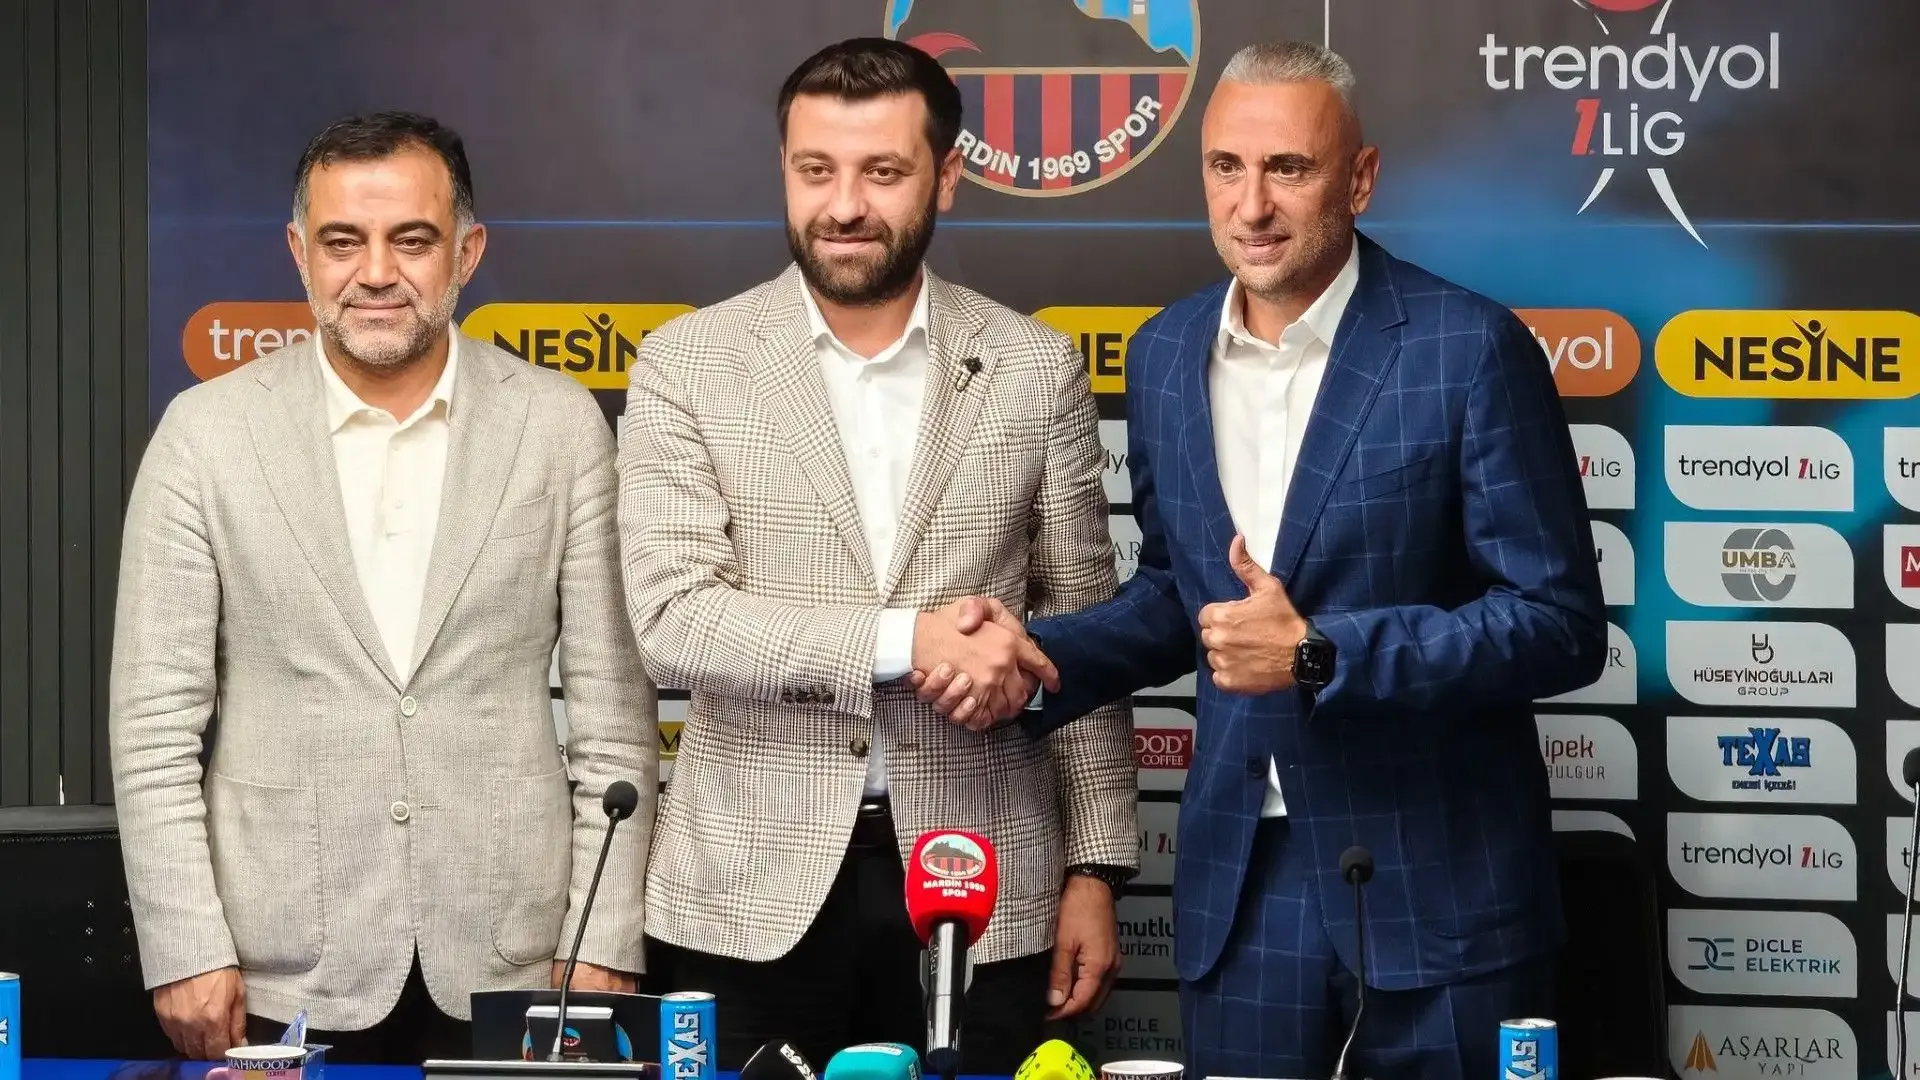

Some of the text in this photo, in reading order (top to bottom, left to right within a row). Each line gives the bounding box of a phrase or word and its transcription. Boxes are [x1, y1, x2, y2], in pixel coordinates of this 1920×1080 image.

[1479, 32, 1780, 102] trendyol
[1028, 149, 1092, 181] 1969
[1093, 95, 1163, 163] SPOR
[1678, 454, 1789, 481] trendyol
[1721, 551, 1796, 569] UMBA
[1737, 686, 1790, 696] GROUP
[1141, 754, 1184, 766] COFFEE
[1545, 734, 1594, 764] ipek
[1680, 841, 1792, 869] trendyol
[1119, 941, 1169, 957] urizm
[667, 1012, 707, 1080] EXAS
[1716, 1035, 1844, 1063] AŞARLAR
[1757, 1062, 1805, 1076] YAPI
